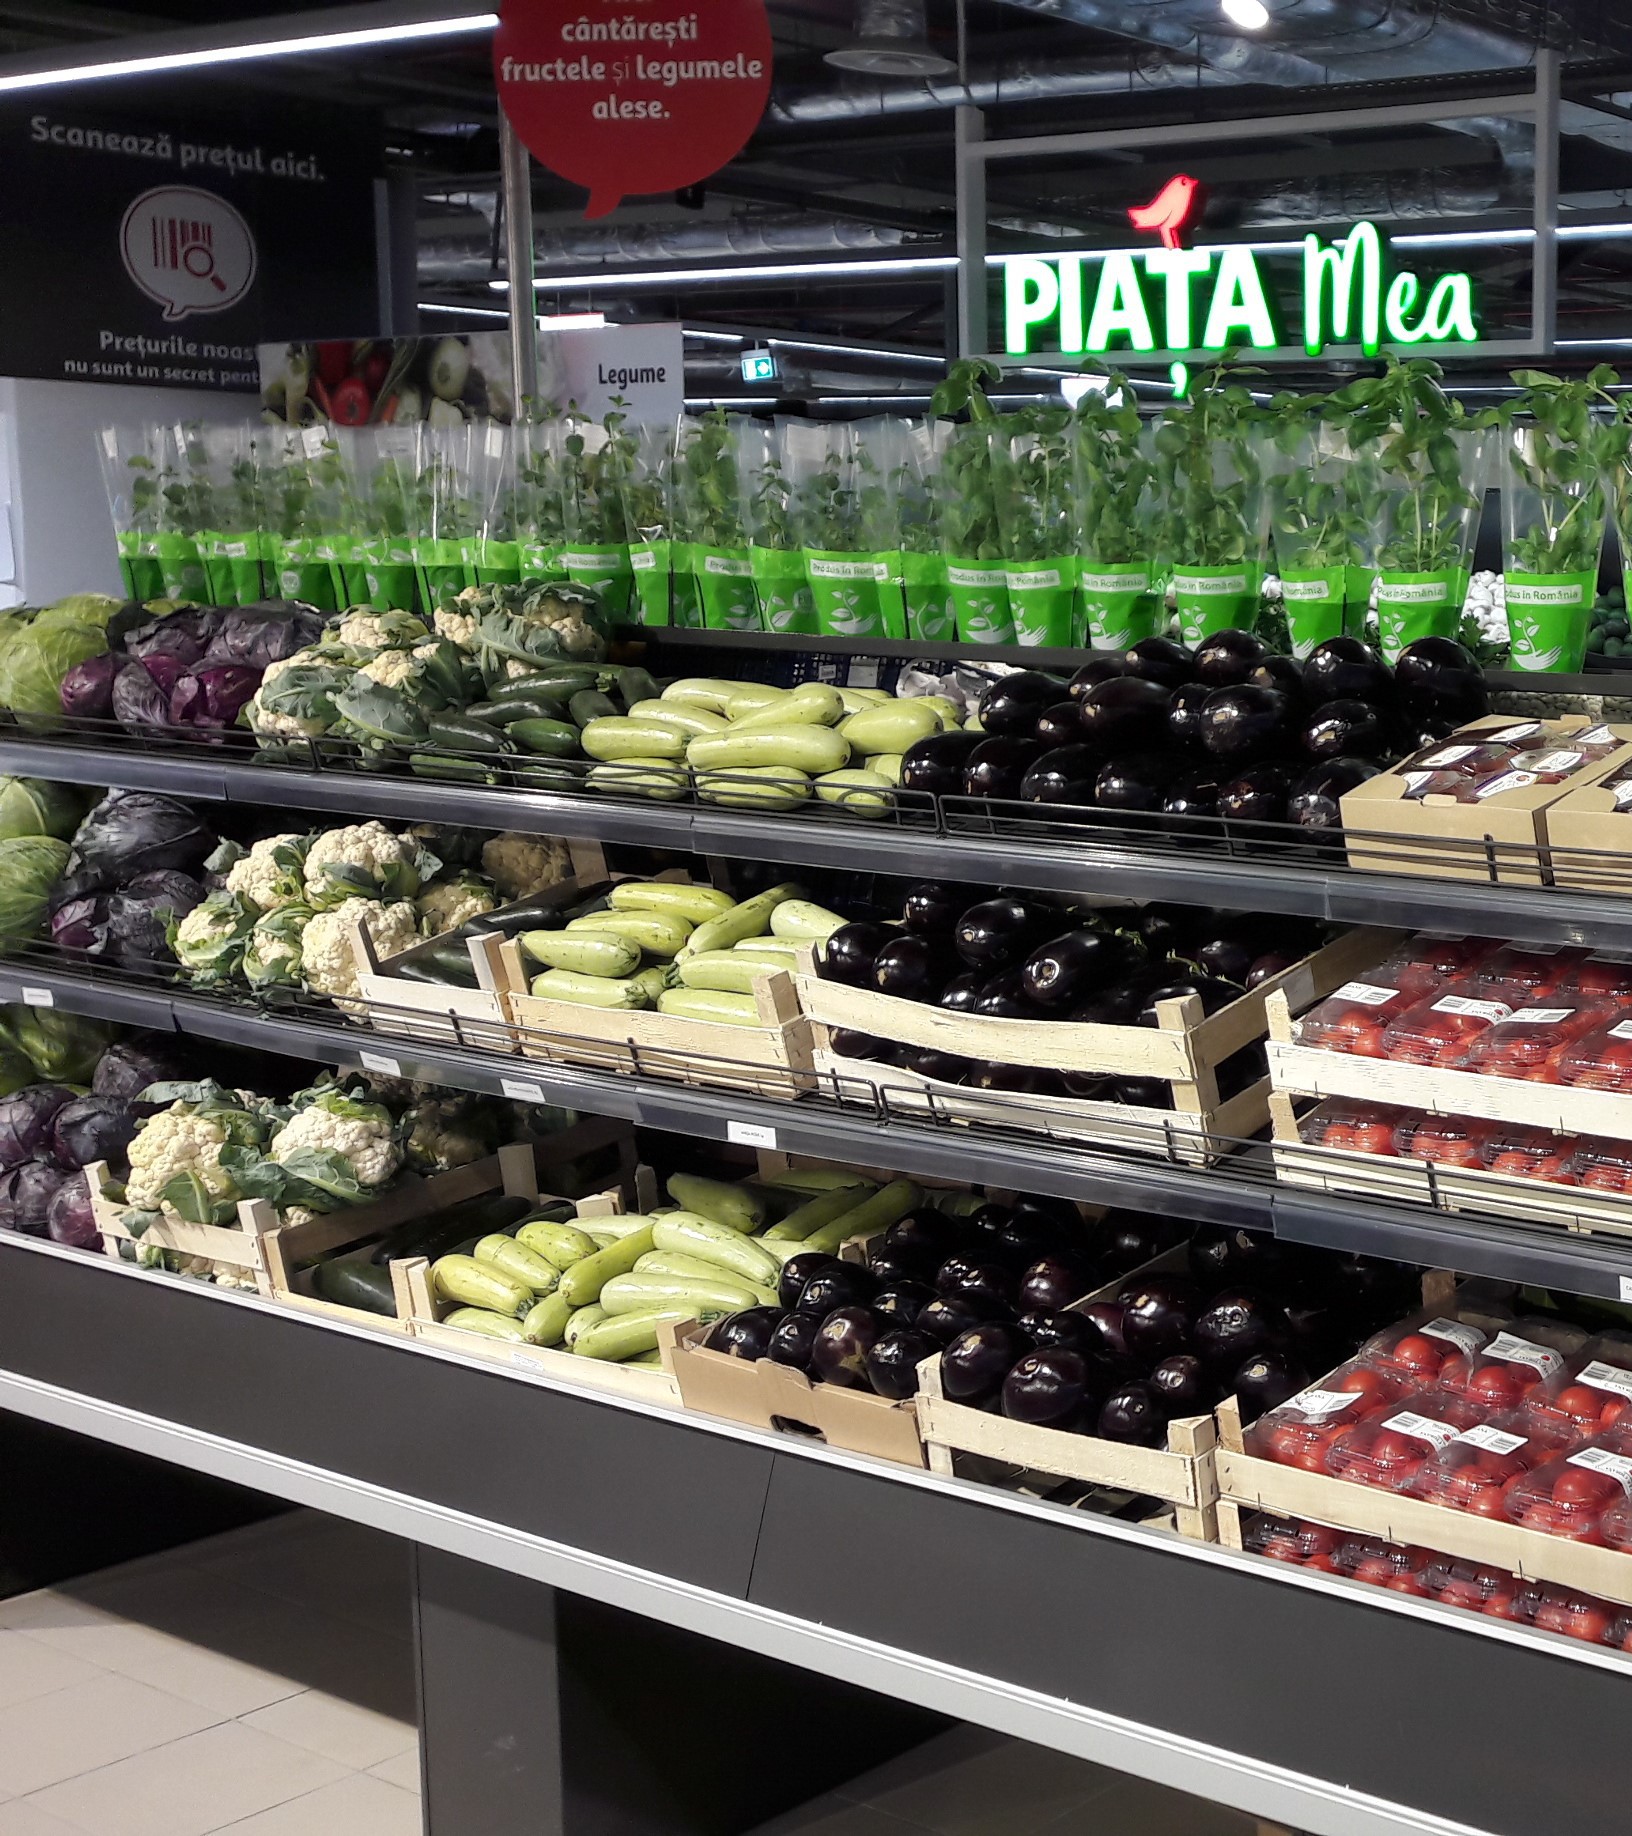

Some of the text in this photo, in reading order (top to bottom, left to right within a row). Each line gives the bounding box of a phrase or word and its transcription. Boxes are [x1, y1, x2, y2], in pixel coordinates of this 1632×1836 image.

[561, 13, 698, 48] cântărești
[501, 52, 763, 87] fructele și legumele
[592, 94, 671, 120] alese.
[31, 115, 326, 181] Scanează prețul aici.
[1303, 220, 1479, 357] Mea
[100, 330, 198, 360] Prețurile
[64, 359, 88, 374] nu
[92, 360, 132, 378] sunt
[137, 365, 159, 379] un
[164, 367, 215, 384] secret
[598, 364, 667, 391] Legume
